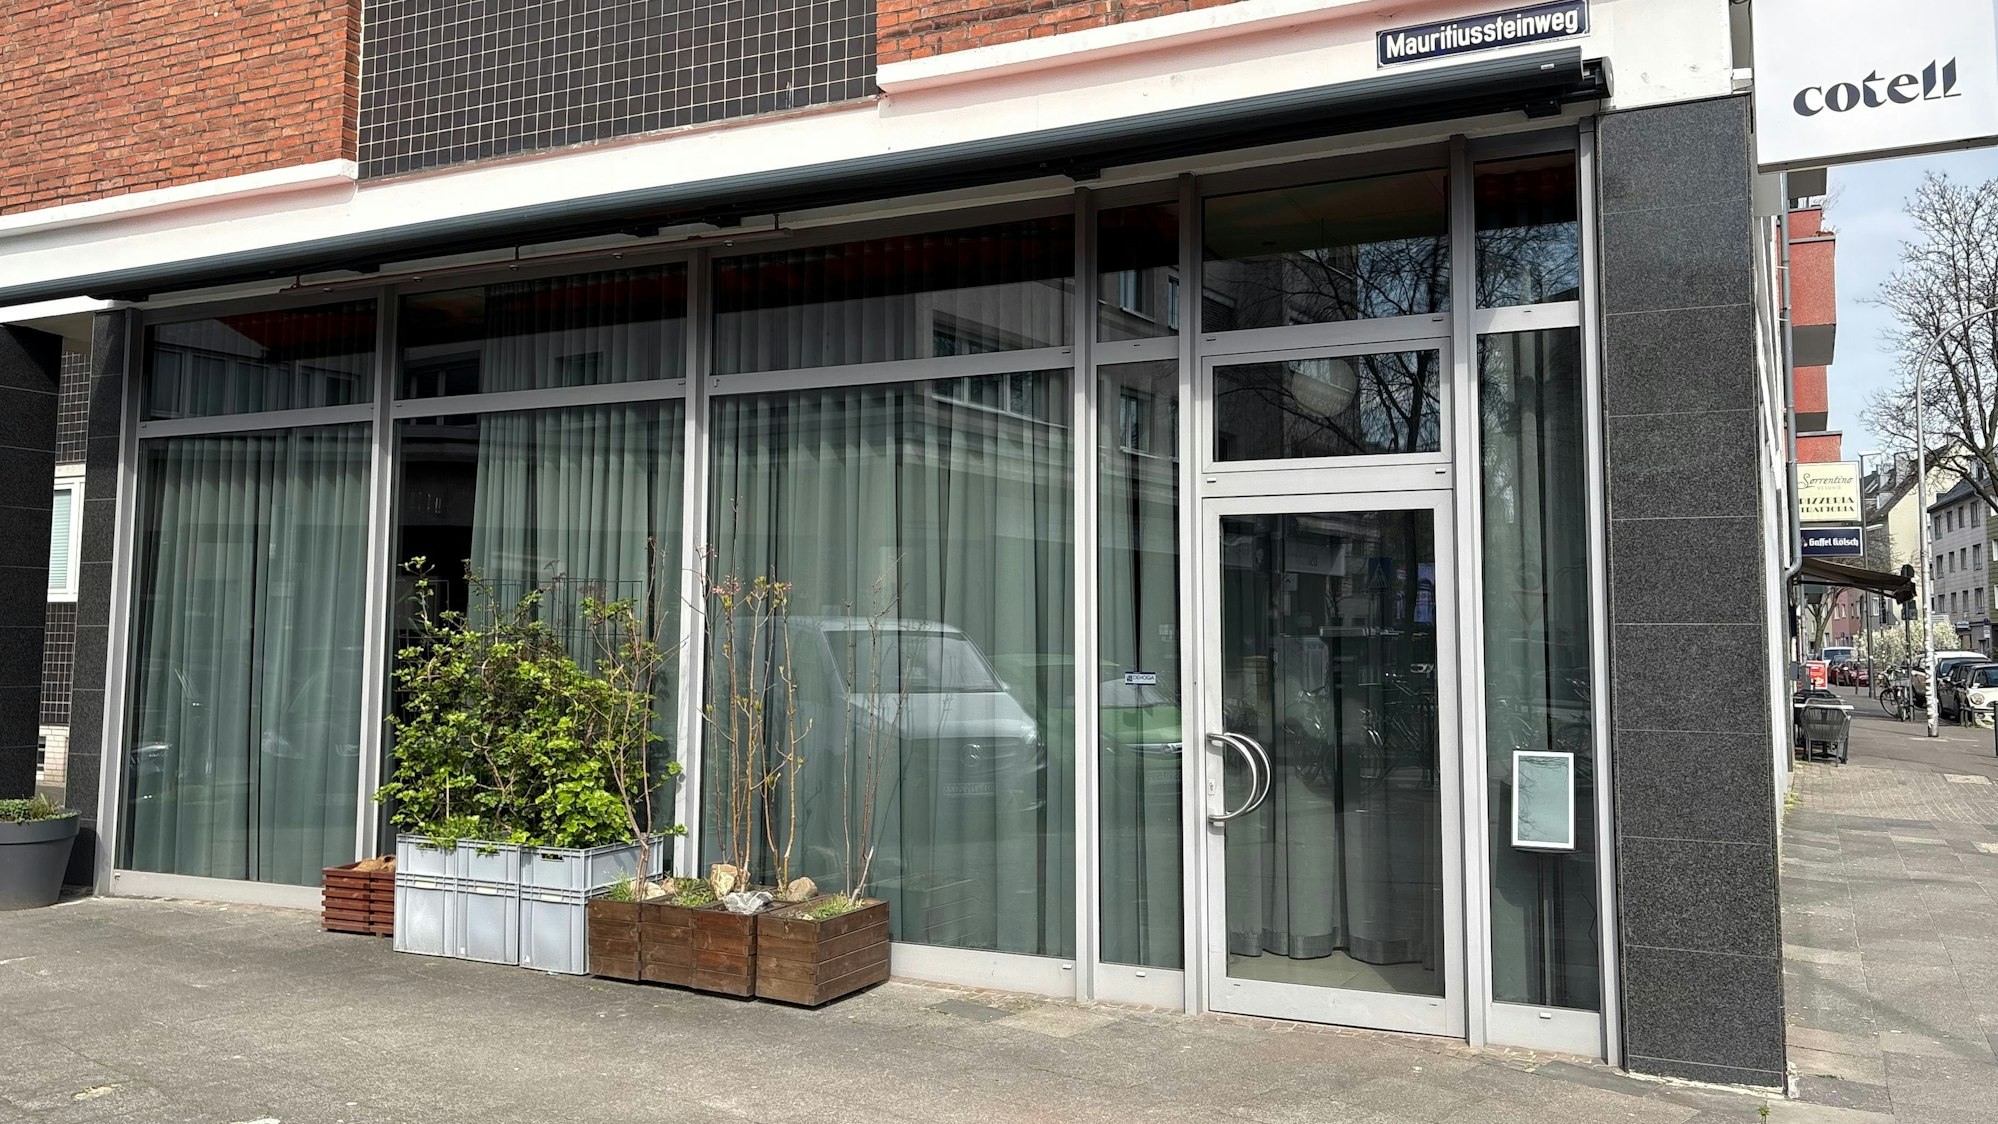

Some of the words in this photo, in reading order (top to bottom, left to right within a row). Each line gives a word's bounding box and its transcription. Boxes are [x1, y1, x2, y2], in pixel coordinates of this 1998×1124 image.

[1386, 8, 1580, 59] Mauritiussteinweg
[1793, 56, 1962, 117] cotell
[1798, 473, 1853, 489] Sorrentino
[1809, 538, 1832, 547] Gaffel
[1833, 538, 1859, 547] Kölsch
